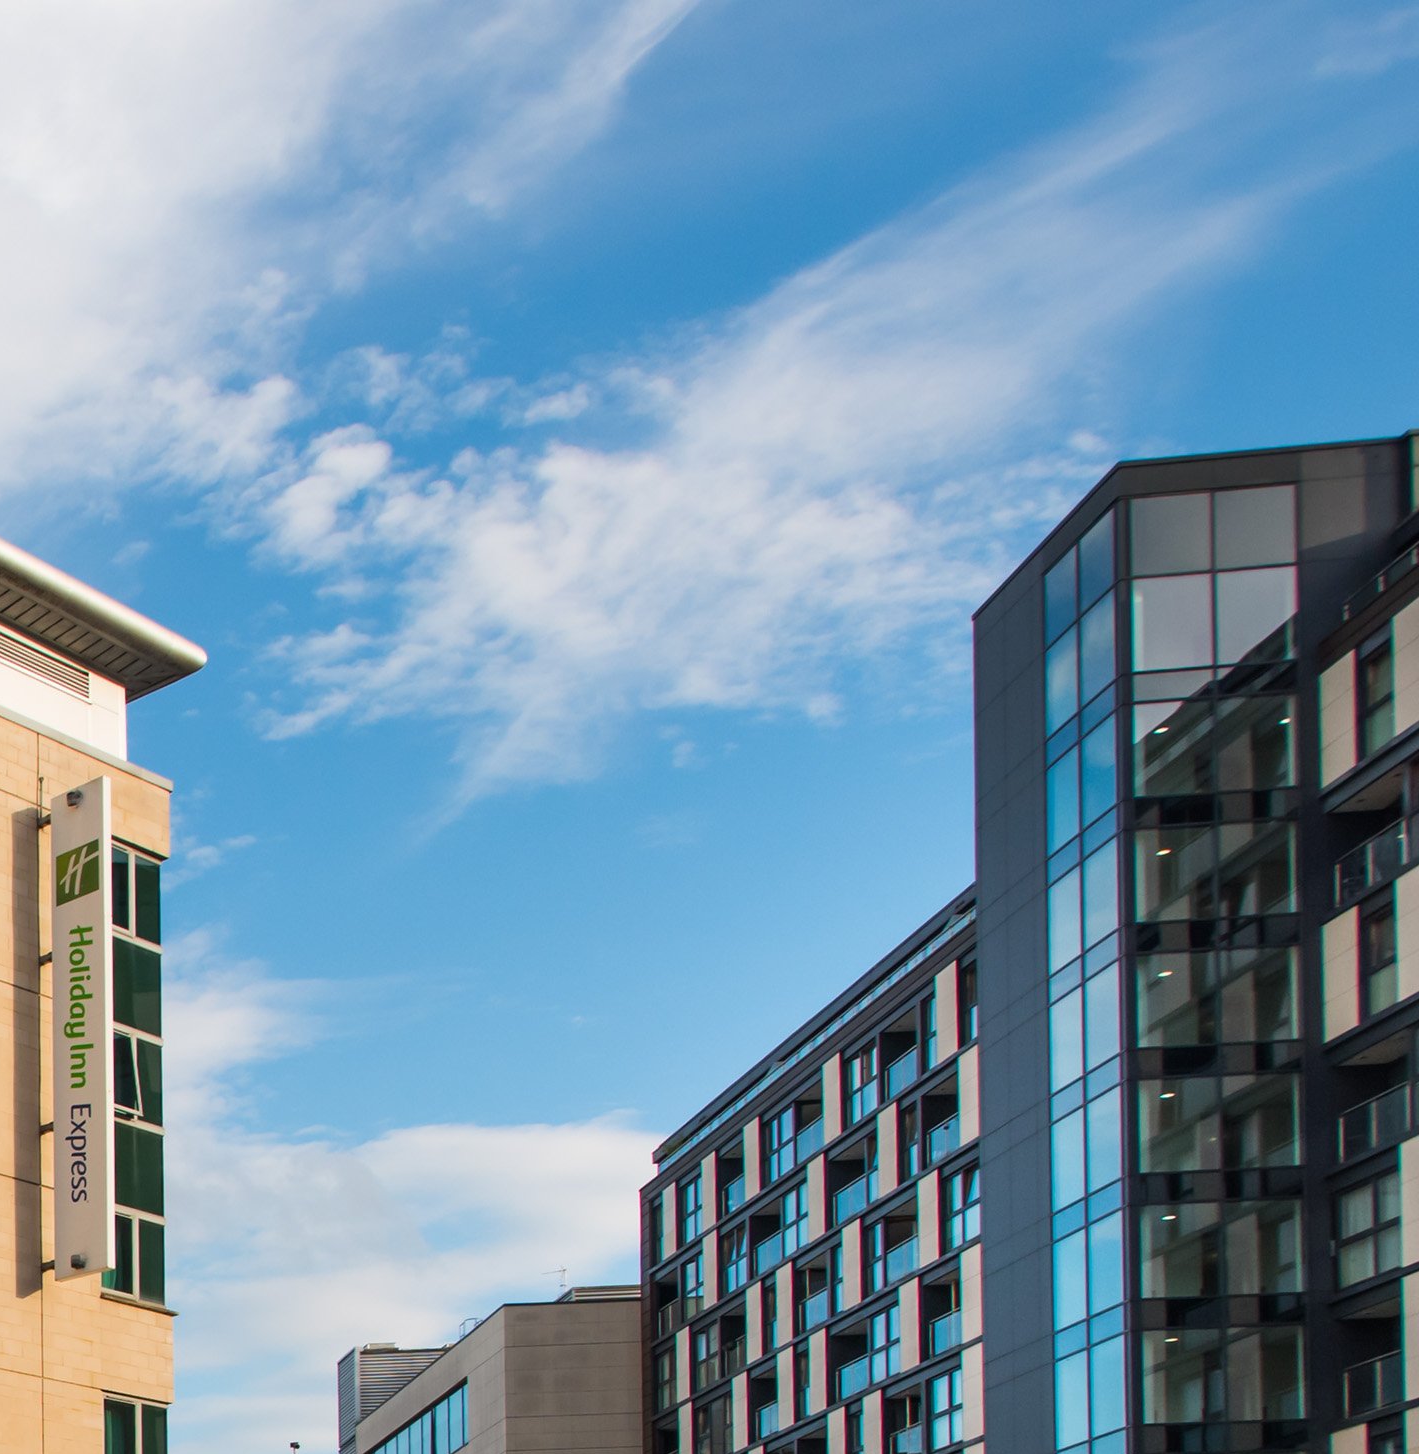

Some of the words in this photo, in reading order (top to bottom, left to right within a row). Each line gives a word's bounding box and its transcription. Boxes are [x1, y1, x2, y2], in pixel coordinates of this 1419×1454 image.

[63, 925, 94, 1039] Holiday
[69, 1043, 94, 1089] Inn
[65, 1103, 91, 1203] Express
